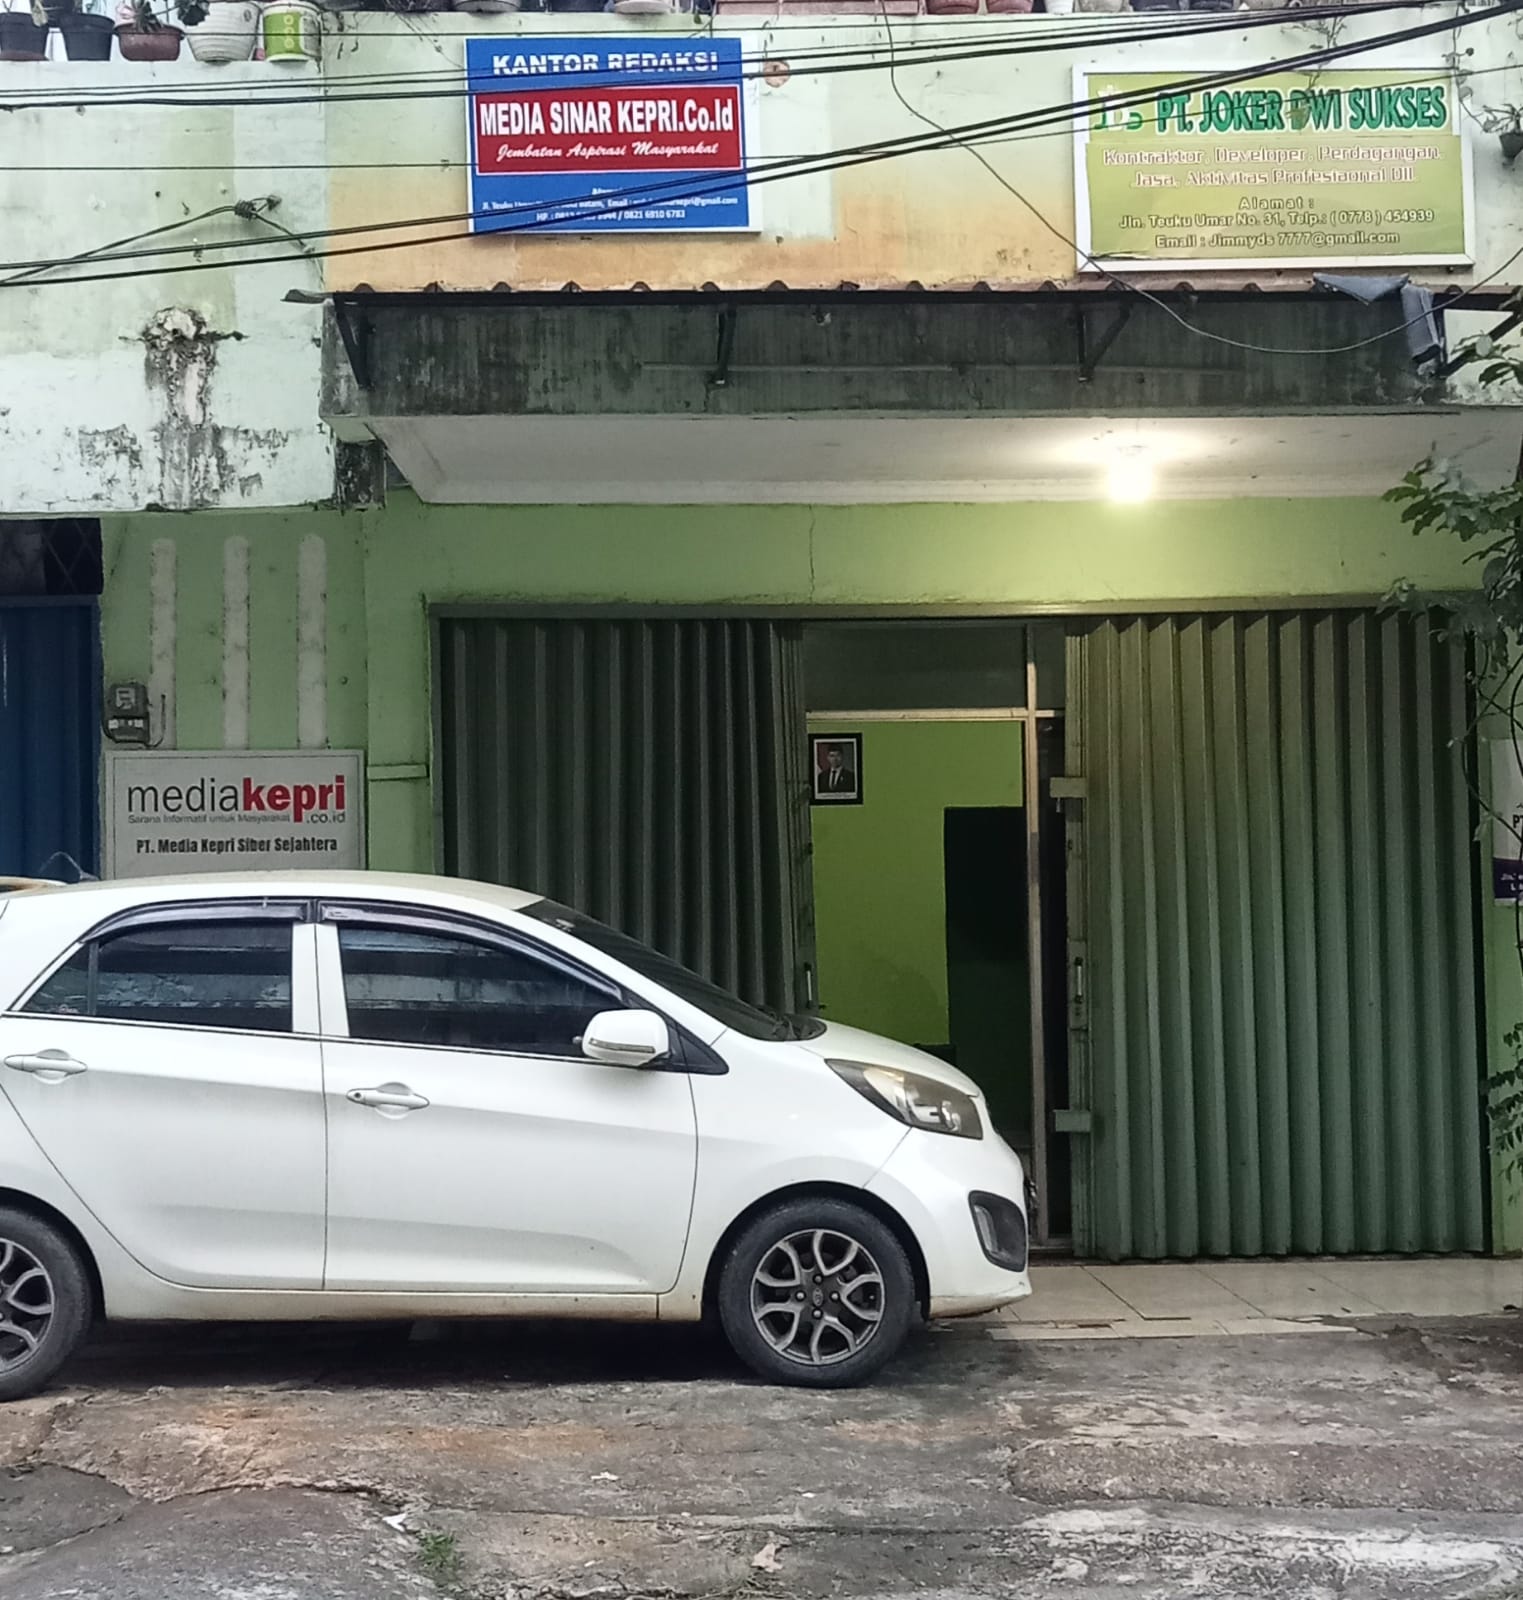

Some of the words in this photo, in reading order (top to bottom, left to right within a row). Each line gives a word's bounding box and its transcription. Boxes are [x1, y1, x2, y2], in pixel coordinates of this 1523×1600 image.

[492, 53, 599, 75] KANTOR
[607, 51, 719, 72] REDAKSI
[480, 103, 545, 136] MEDIA
[550, 101, 612, 134] SINAR
[617, 98, 734, 133] KEPRI.Co.Id
[1156, 92, 1194, 133] PT.
[1199, 89, 1285, 132] JOKER
[1289, 88, 1342, 130] DWI
[1348, 86, 1447, 130] SUKSES
[496, 143, 562, 162] Jembatan
[566, 142, 626, 160] Aspirasi
[631, 141, 719, 157] Masyarakat
[1187, 170, 1268, 185] Aktivitas
[1239, 197, 1303, 209] Alamat
[624, 210, 643, 219] 0821
[1119, 215, 1145, 229] Jln.
[1149, 214, 1193, 228] Teuku
[1195, 213, 1233, 227] Umar
[1236, 212, 1261, 225] No.
[1264, 211, 1286, 226] 31,
[1339, 210, 1373, 224] 0778
[1384, 209, 1434, 223] 454939
[1155, 234, 1197, 248] Email
[1208, 233, 1275, 249] Jimmyds
[1278, 231, 1400, 247] 7777@gmail.com
[136, 839, 155, 853] PT.
[158, 839, 198, 853] Media
[201, 838, 235, 854] Kepri
[237, 837, 271, 852] Siber
[274, 836, 338, 852] Sejahtera
